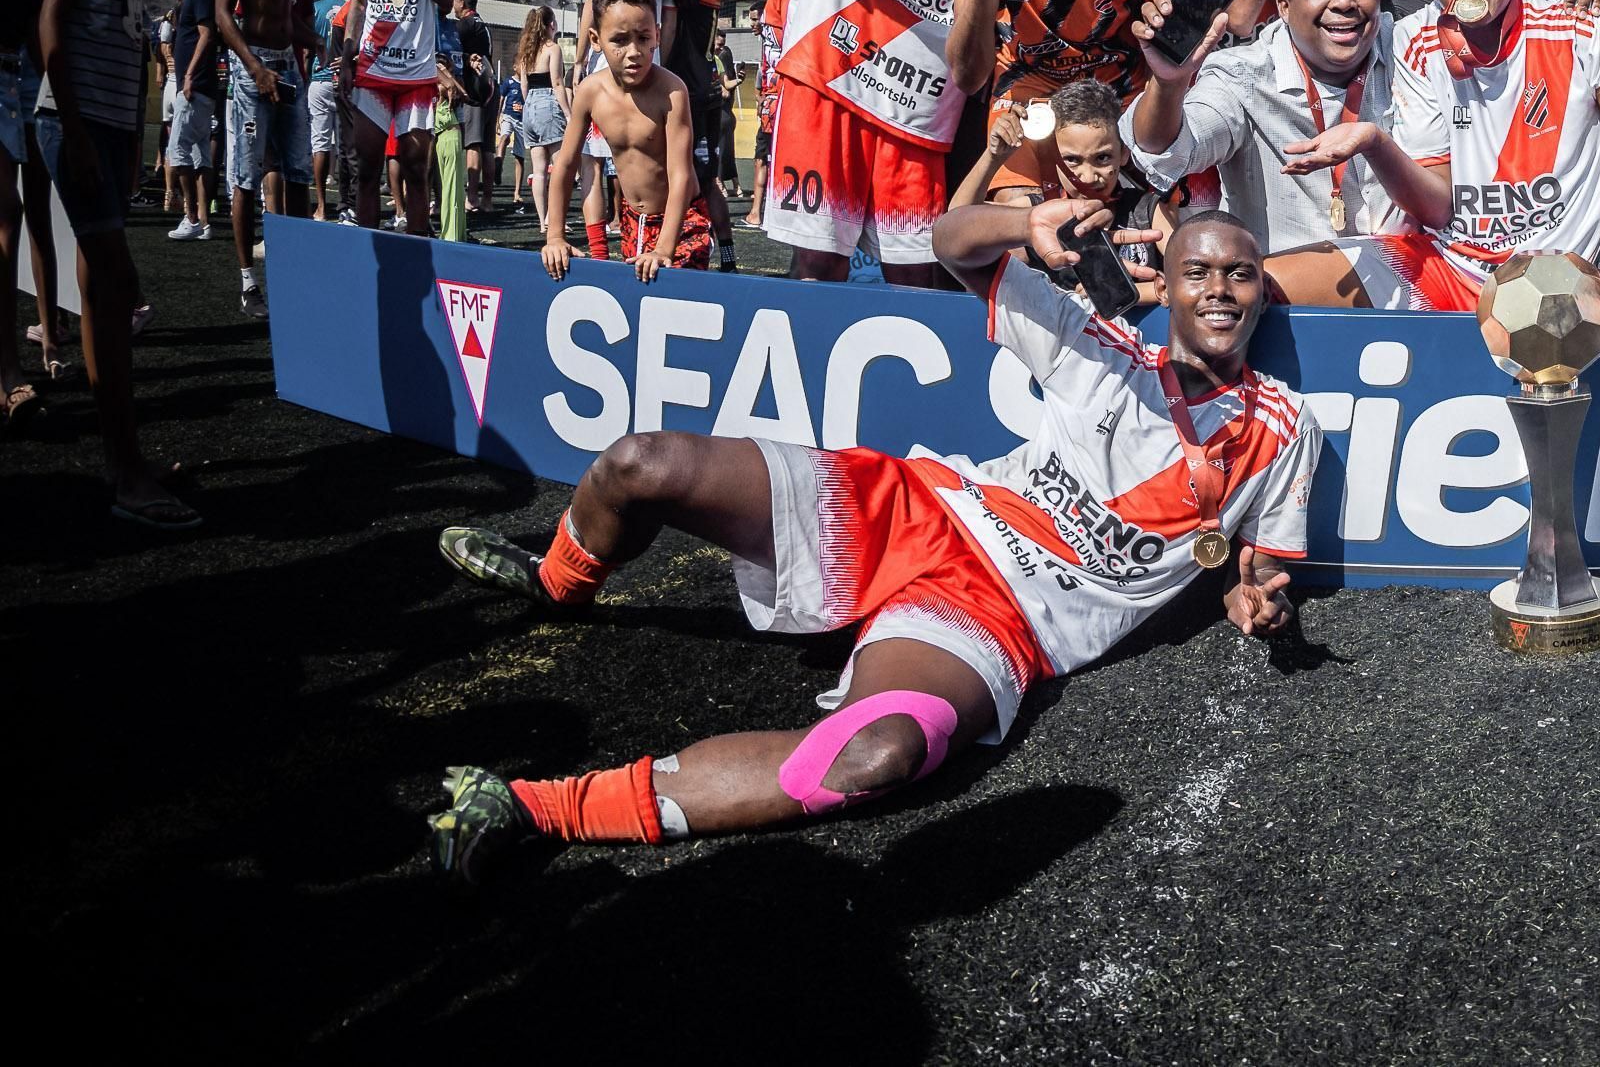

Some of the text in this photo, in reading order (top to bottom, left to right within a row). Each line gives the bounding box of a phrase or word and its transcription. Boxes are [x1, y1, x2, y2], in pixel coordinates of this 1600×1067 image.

[831, 16, 860, 52] DL
[860, 39, 948, 98] SPORTS
[1453, 106, 1472, 124] DL
[781, 164, 824, 216] 20
[1454, 176, 1562, 216] RENO
[1451, 202, 1566, 239] OLASCO
[449, 288, 490, 323] FMF
[543, 285, 952, 458] SFAC
